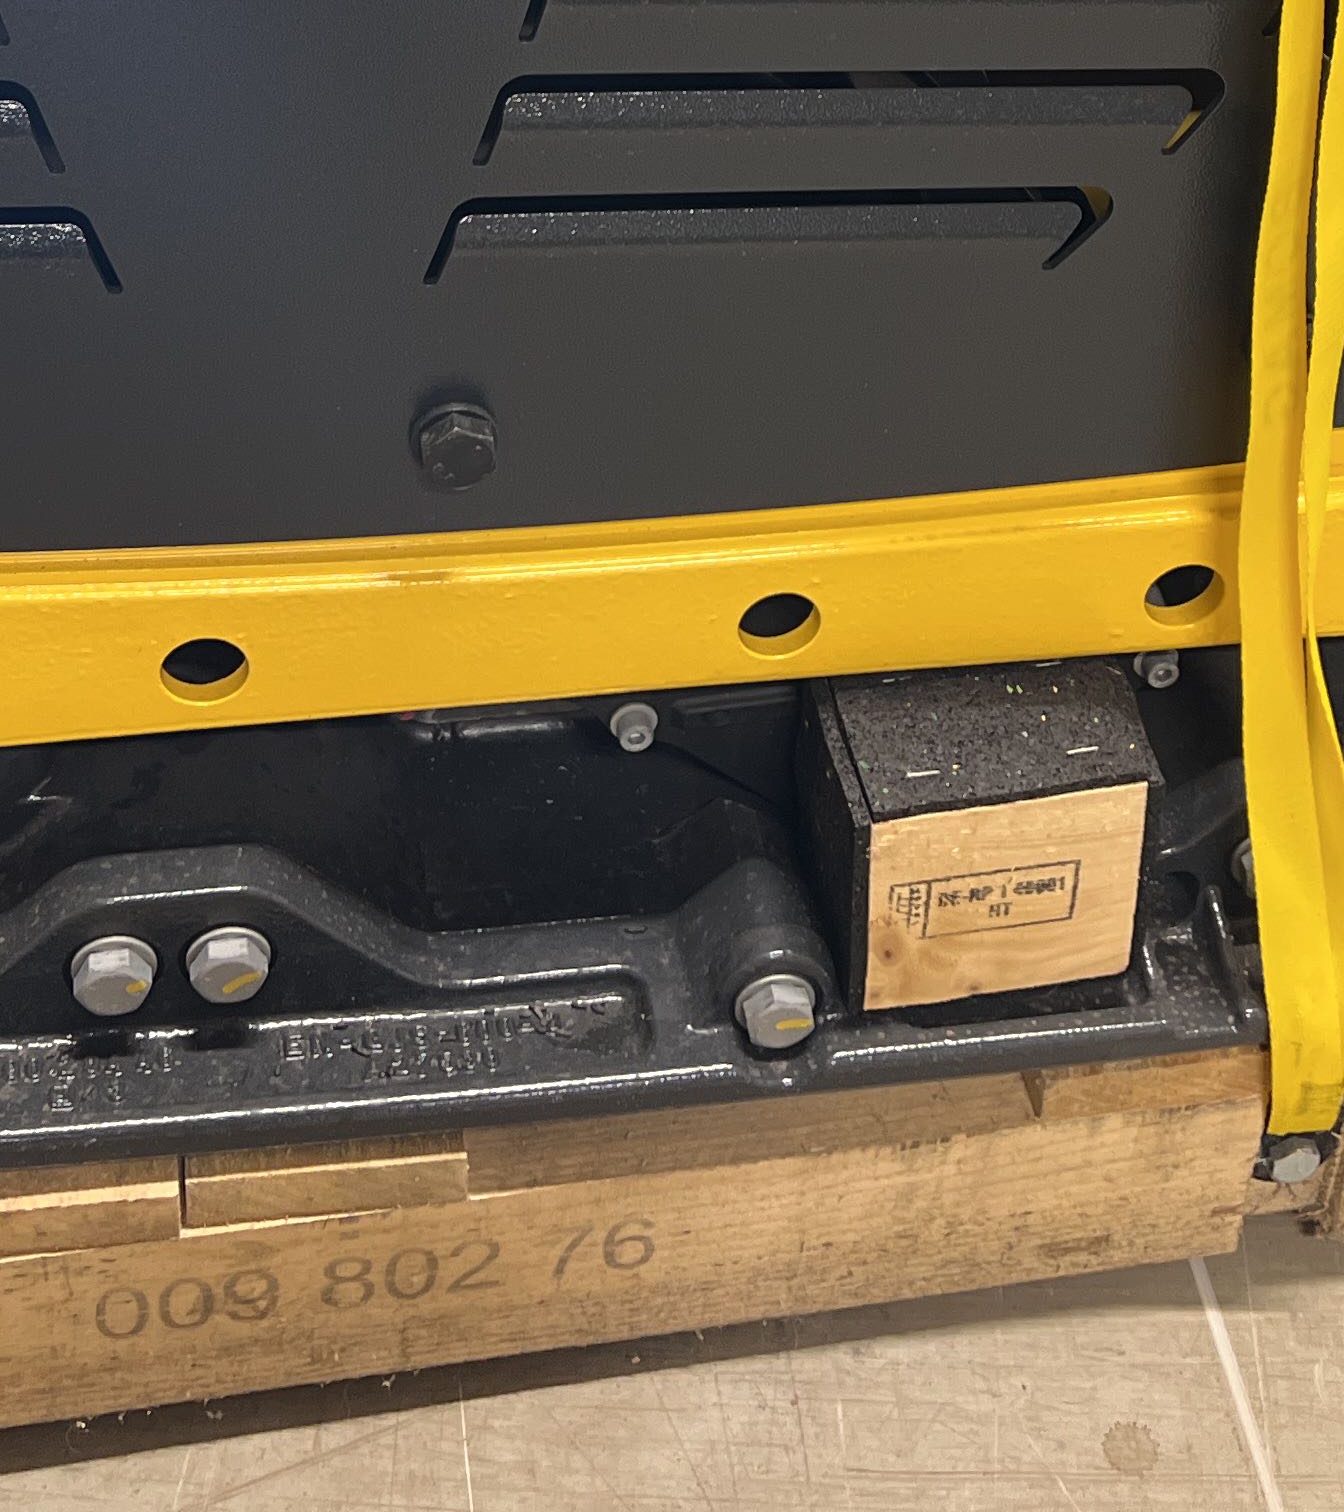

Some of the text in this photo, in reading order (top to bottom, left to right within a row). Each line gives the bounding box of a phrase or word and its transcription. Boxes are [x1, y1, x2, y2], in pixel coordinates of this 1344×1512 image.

[93, 1215, 658, 1340] 009 802 76
